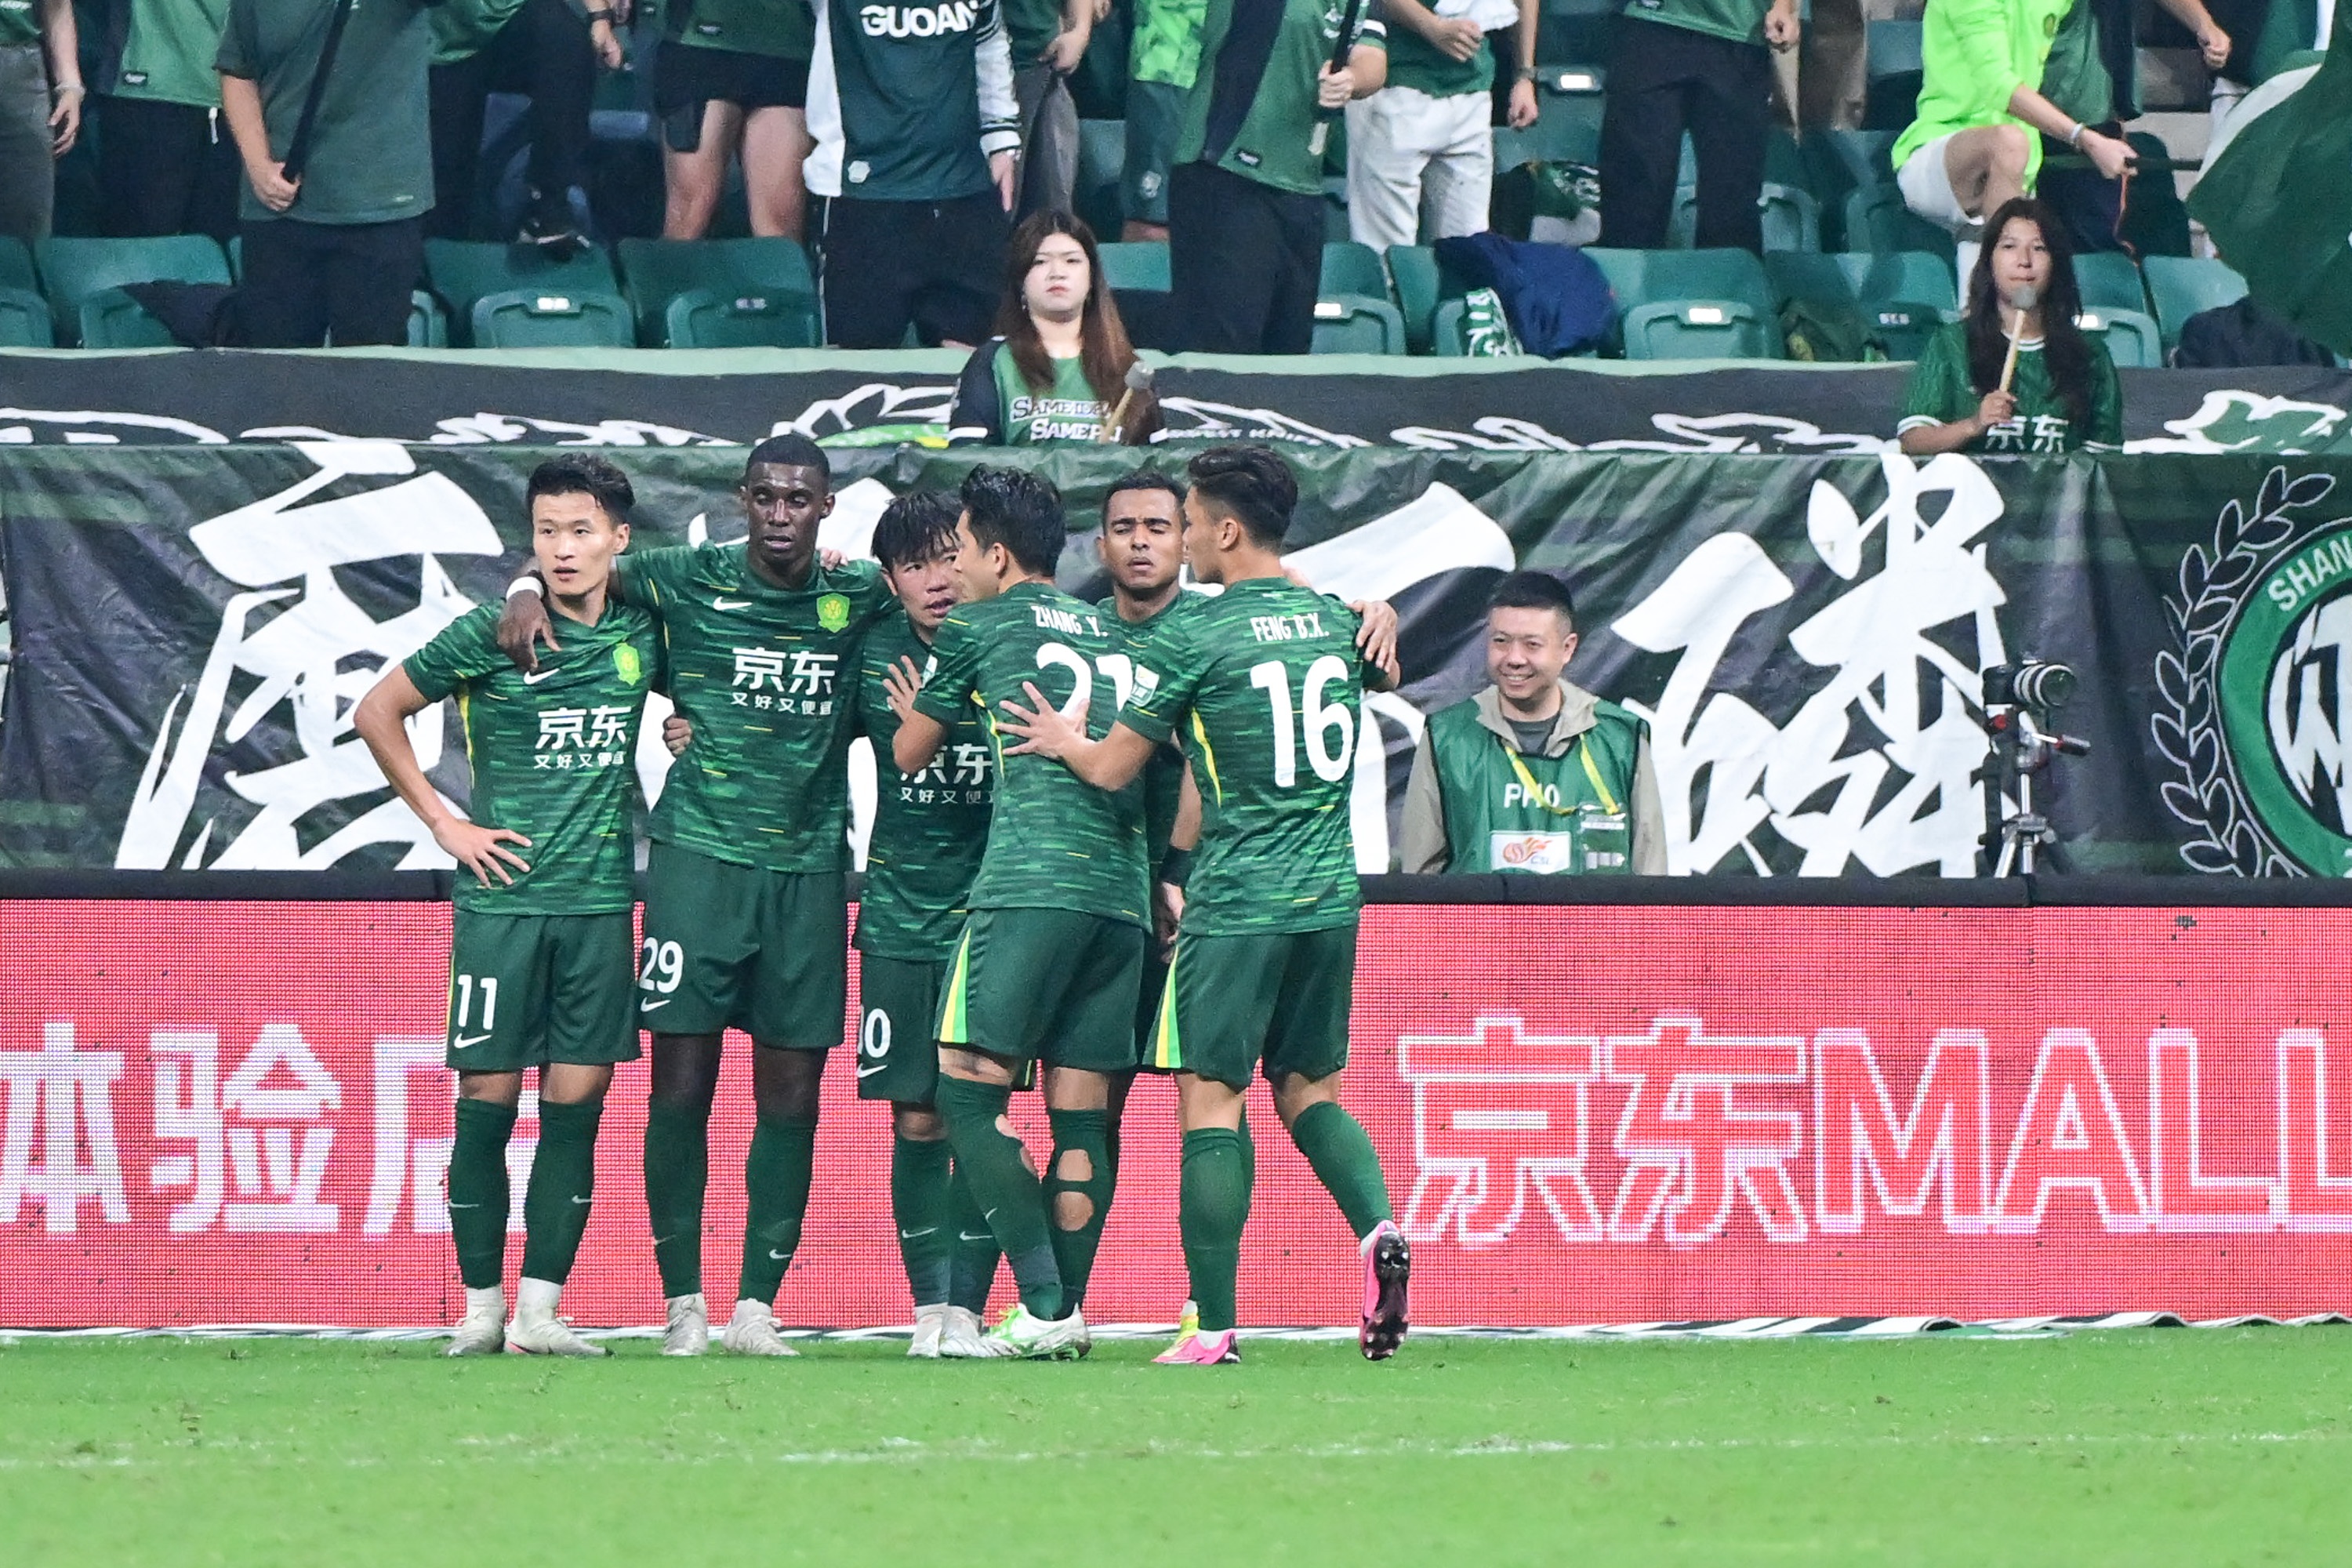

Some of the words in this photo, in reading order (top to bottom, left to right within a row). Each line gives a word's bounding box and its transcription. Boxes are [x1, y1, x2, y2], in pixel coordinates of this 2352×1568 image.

[1985, 414, 2070, 454] 京东
[1031, 605, 1083, 635] ZHANG
[1086, 615, 1109, 637] Y.
[1250, 615, 1292, 641] FENG
[1294, 612, 1330, 639] B.X.
[731, 647, 839, 695] 京东
[730, 691, 833, 716] 又好又便宜
[1250, 655, 1354, 787] 16
[535, 705, 631, 750] 京东
[900, 786, 993, 804] 又好又便
[639, 937, 684, 993] 29
[458, 975, 498, 1030] 11
